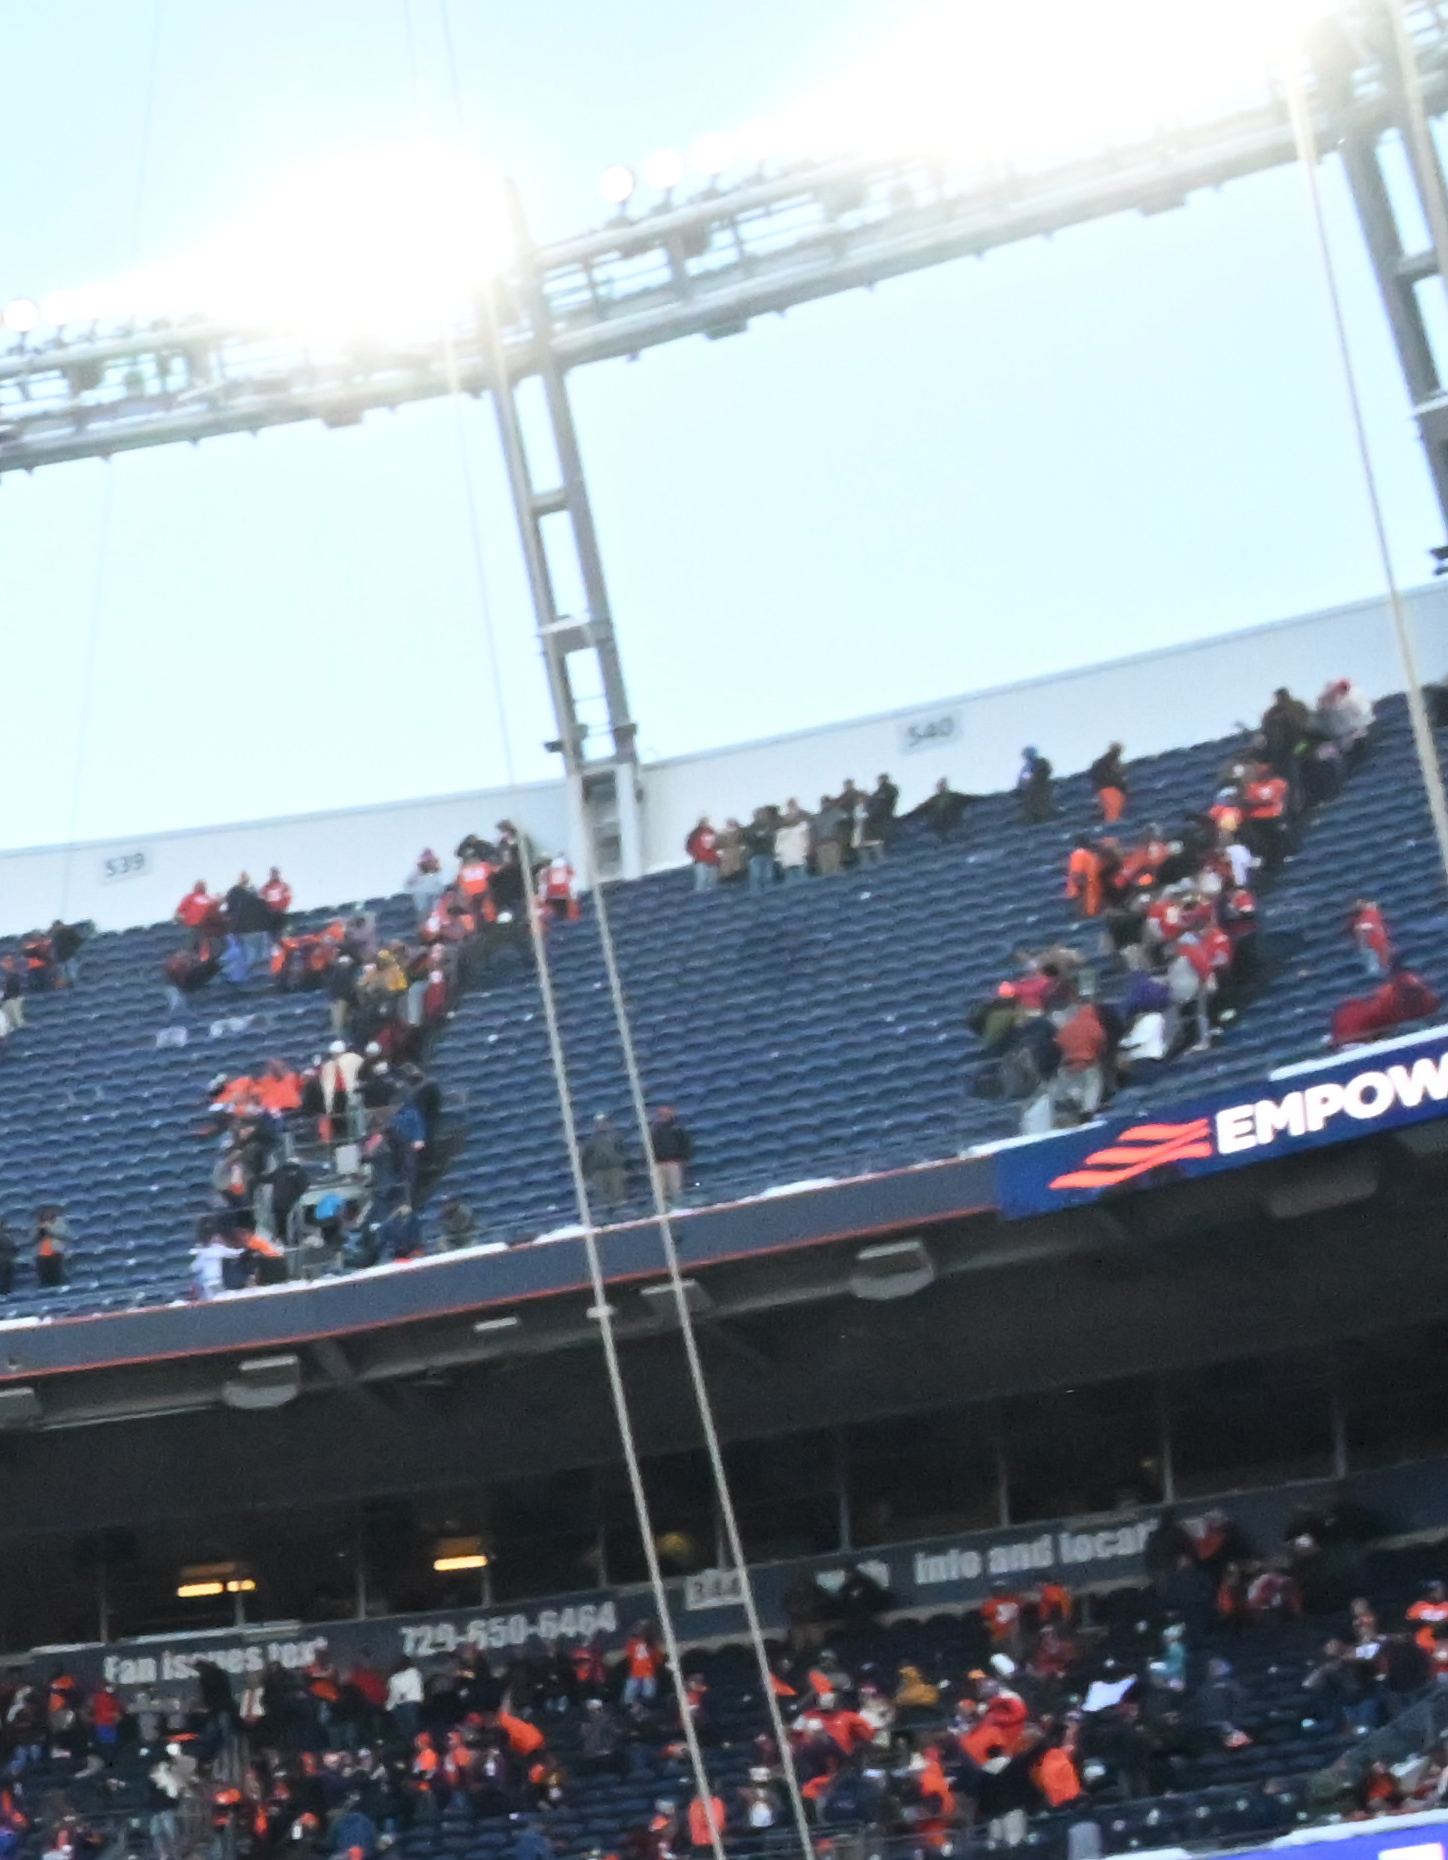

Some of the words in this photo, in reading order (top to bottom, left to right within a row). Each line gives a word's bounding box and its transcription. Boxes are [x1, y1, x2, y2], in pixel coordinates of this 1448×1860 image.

[105, 853, 146, 877] 539
[915, 1549, 982, 1585] info
[989, 1534, 1053, 1575] and
